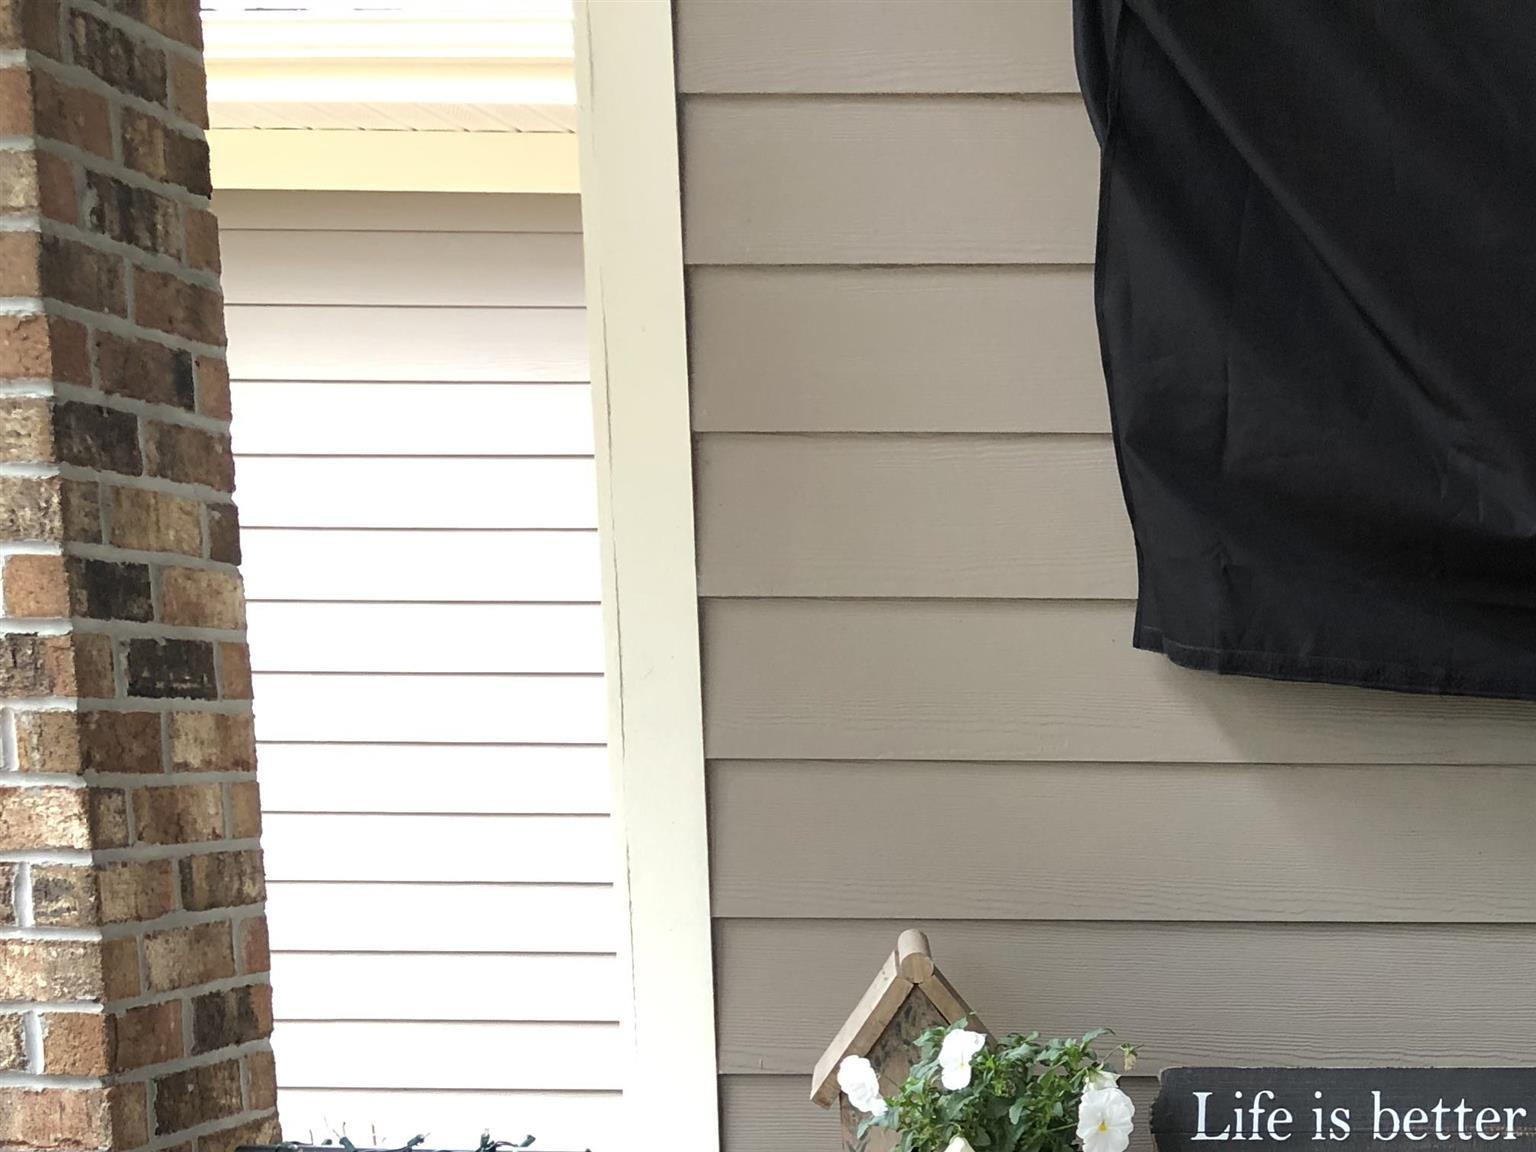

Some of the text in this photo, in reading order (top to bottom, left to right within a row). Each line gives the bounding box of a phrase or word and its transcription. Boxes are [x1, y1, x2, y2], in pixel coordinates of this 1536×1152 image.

[1190, 1090, 1293, 1141] Life
[1311, 1090, 1351, 1141] is
[1371, 1090, 1527, 1141] better
